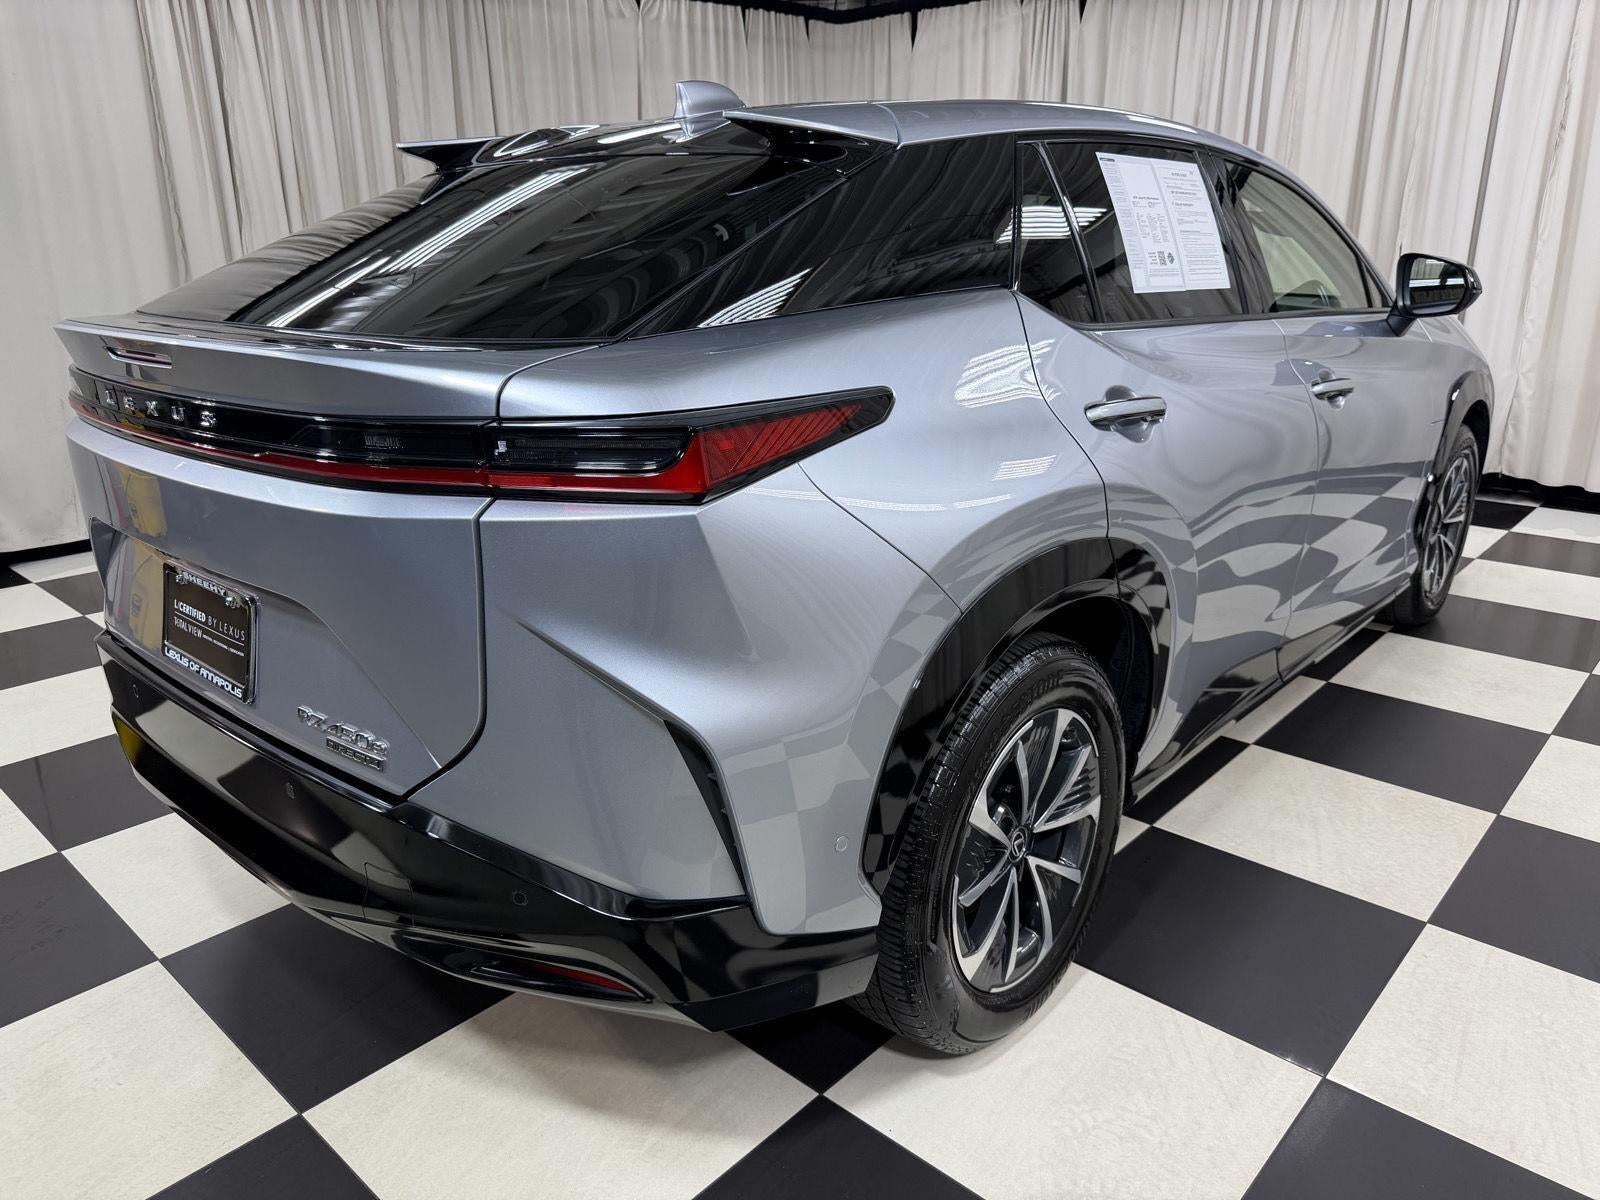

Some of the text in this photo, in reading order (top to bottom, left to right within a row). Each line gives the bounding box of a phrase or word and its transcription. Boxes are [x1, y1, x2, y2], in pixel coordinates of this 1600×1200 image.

[105, 390, 217, 428] LEXUS
[182, 571, 226, 597] SHEEHY
[208, 615, 218, 628] BY
[219, 621, 246, 641] LEXUS
[164, 647, 243, 698] LEXUS OF ANNAPOLIS
